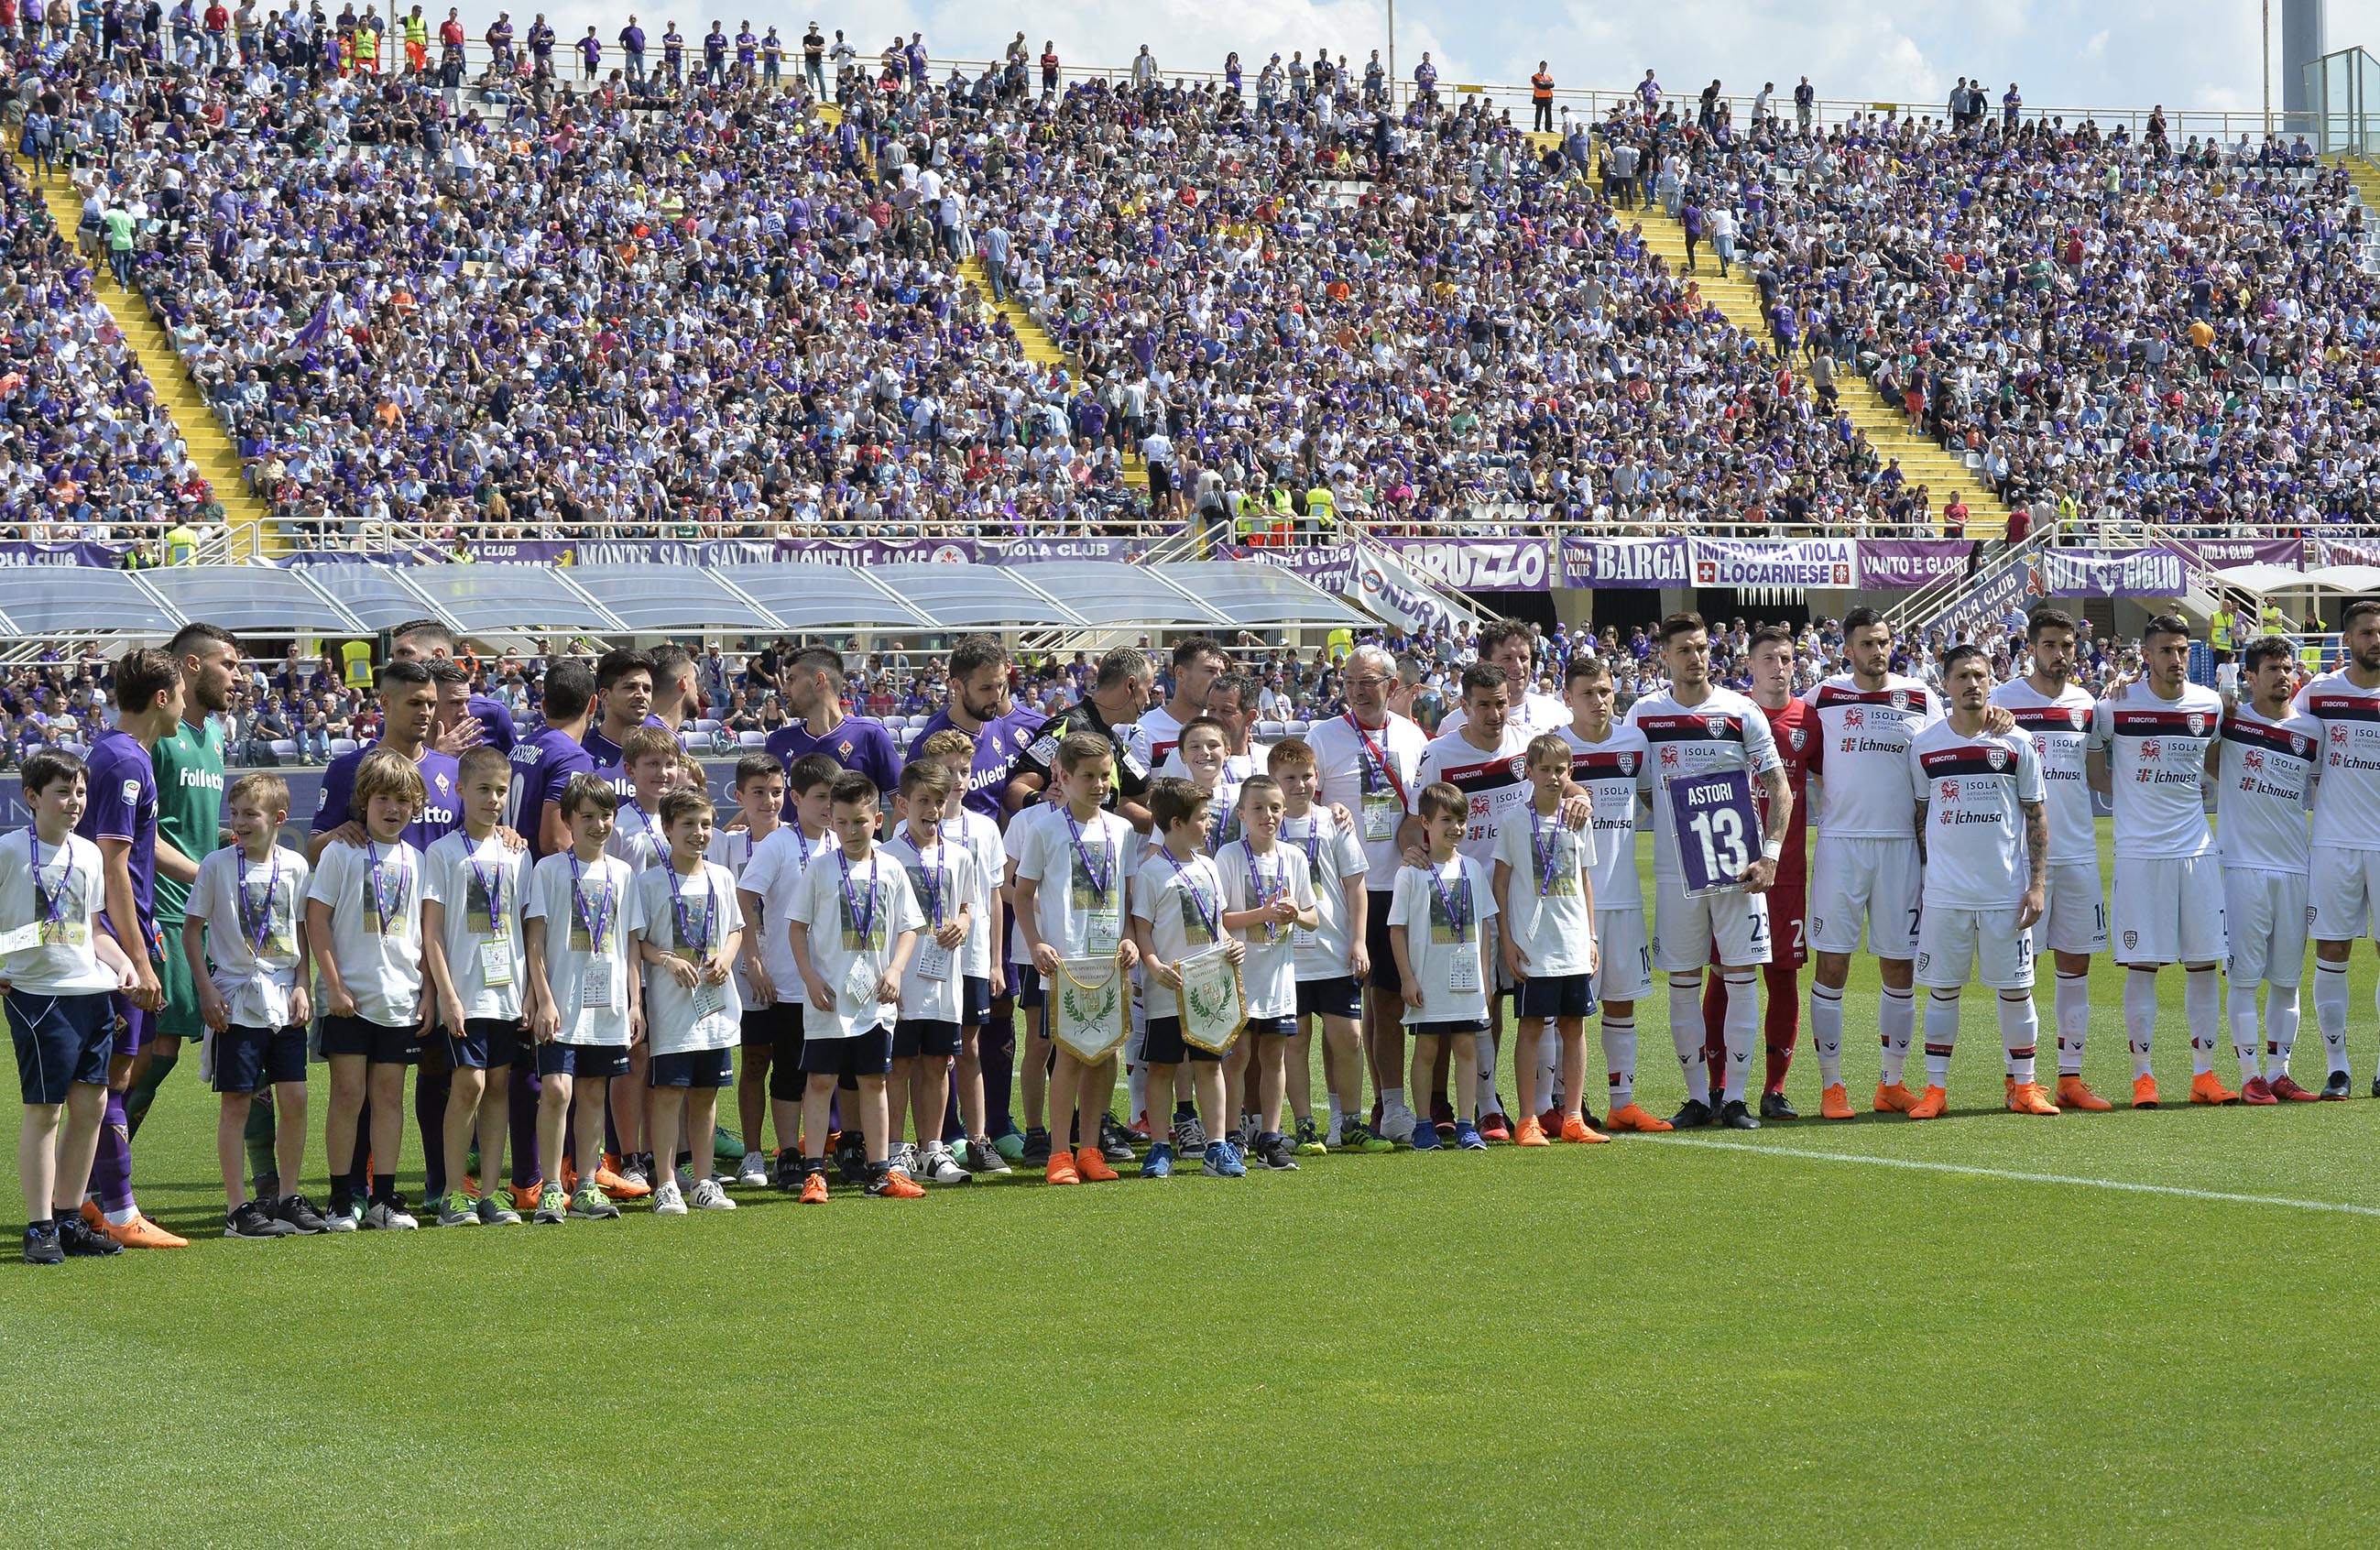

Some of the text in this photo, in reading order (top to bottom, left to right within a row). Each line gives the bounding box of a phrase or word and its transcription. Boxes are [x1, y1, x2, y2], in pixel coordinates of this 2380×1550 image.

[484, 545, 518, 556] CLUB
[998, 543, 1109, 556] VIOLA CLUB
[1563, 549, 1593, 562] VIOLA
[1697, 541, 1849, 562] IMPRONTA VIOLA
[2198, 545, 2254, 560] VIOLA CLUB
[34, 552, 77, 566] CLUB
[1307, 548, 1351, 567] CLUB
[1595, 544, 1687, 579] BARGA
[1384, 543, 1545, 586] ABRUZZO
[1567, 563, 1590, 576] CLUB
[1861, 556, 1909, 573] VANTO
[1913, 556, 1923, 573] E
[1719, 563, 1829, 584] LOCARNESE
[2123, 555, 2180, 589] GIGLIO
[1983, 573, 2016, 606] CLUB
[1832, 693, 1859, 701] macron
[1872, 712, 1904, 722] ISOLA
[2235, 724, 2264, 737] macron
[2355, 729, 2380, 738] ISOL
[2052, 739, 2080, 748] ISOLA
[2167, 743, 2198, 751] ISOLA
[1929, 754, 1957, 764] macron
[2271, 758, 2300, 771] ISOLA
[2344, 755, 2380, 770] ichnus
[1453, 770, 1482, 780] macron
[1966, 781, 1998, 790] ISOLA
[1496, 791, 1523, 803] ISOLA
[1688, 782, 1733, 806] ASTORI
[1689, 807, 1749, 881] 13
